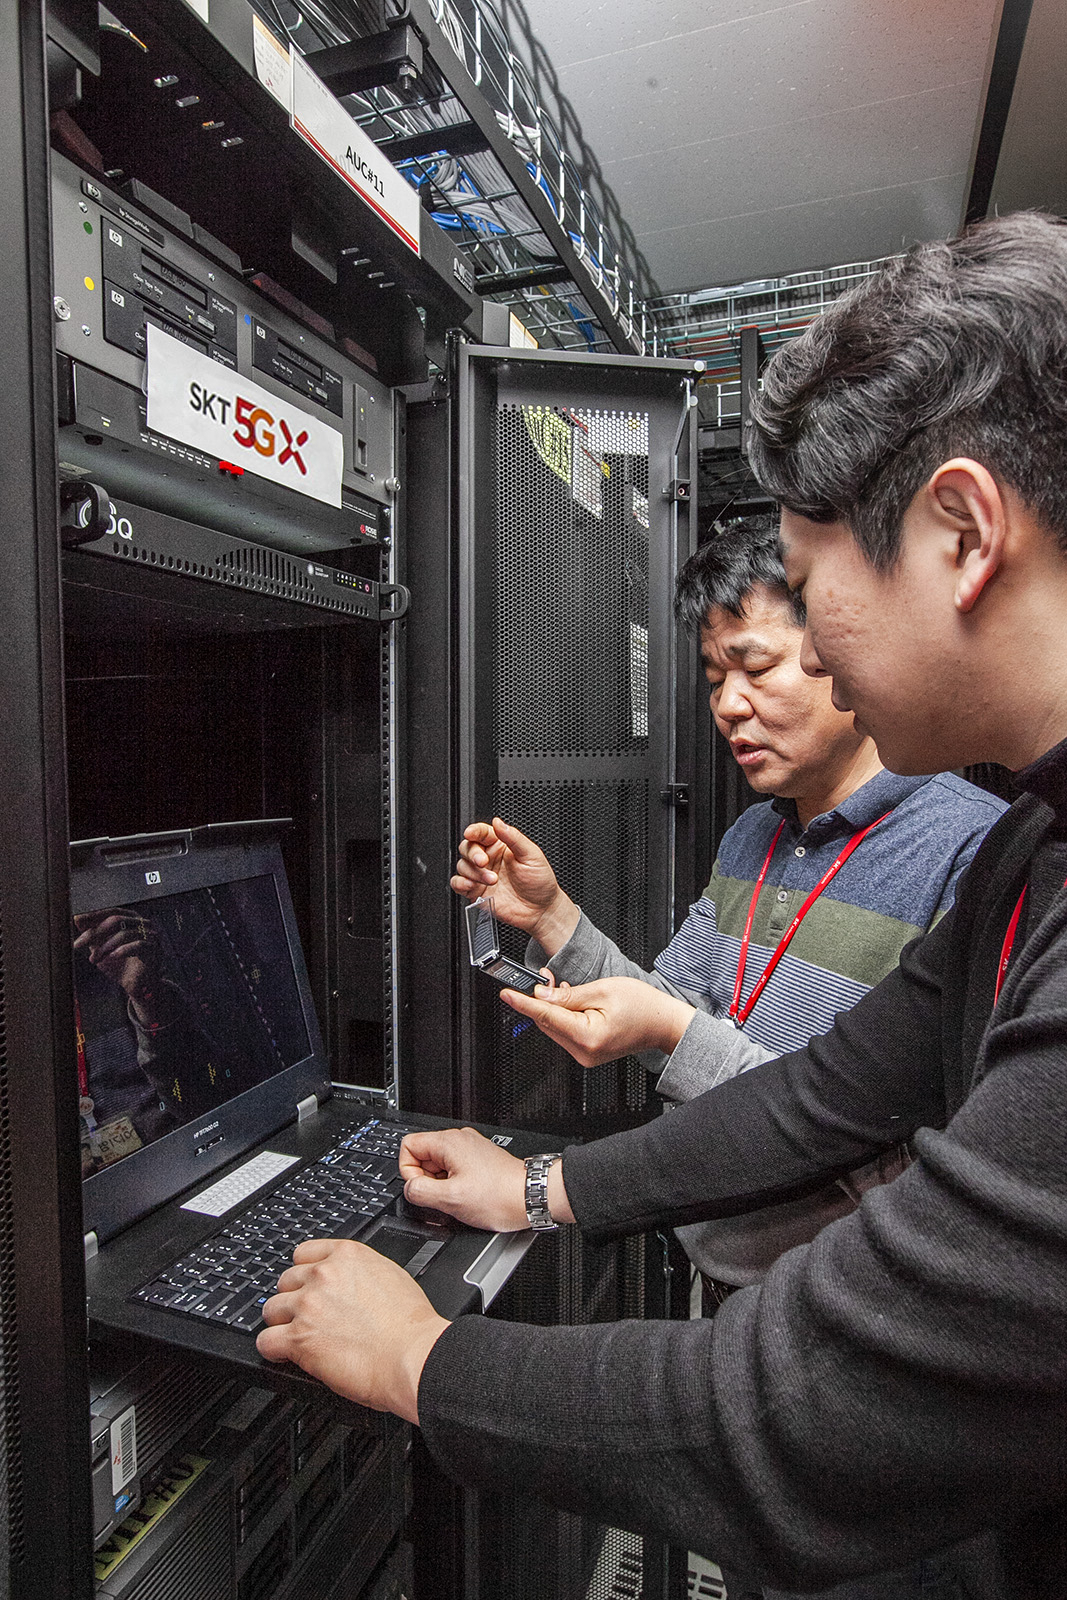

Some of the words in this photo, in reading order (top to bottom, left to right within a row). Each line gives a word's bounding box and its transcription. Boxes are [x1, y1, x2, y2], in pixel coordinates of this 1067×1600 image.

[345, 145, 385, 198] AUC#11
[189, 382, 231, 425] SKT
[233, 396, 309, 476] 5GX
